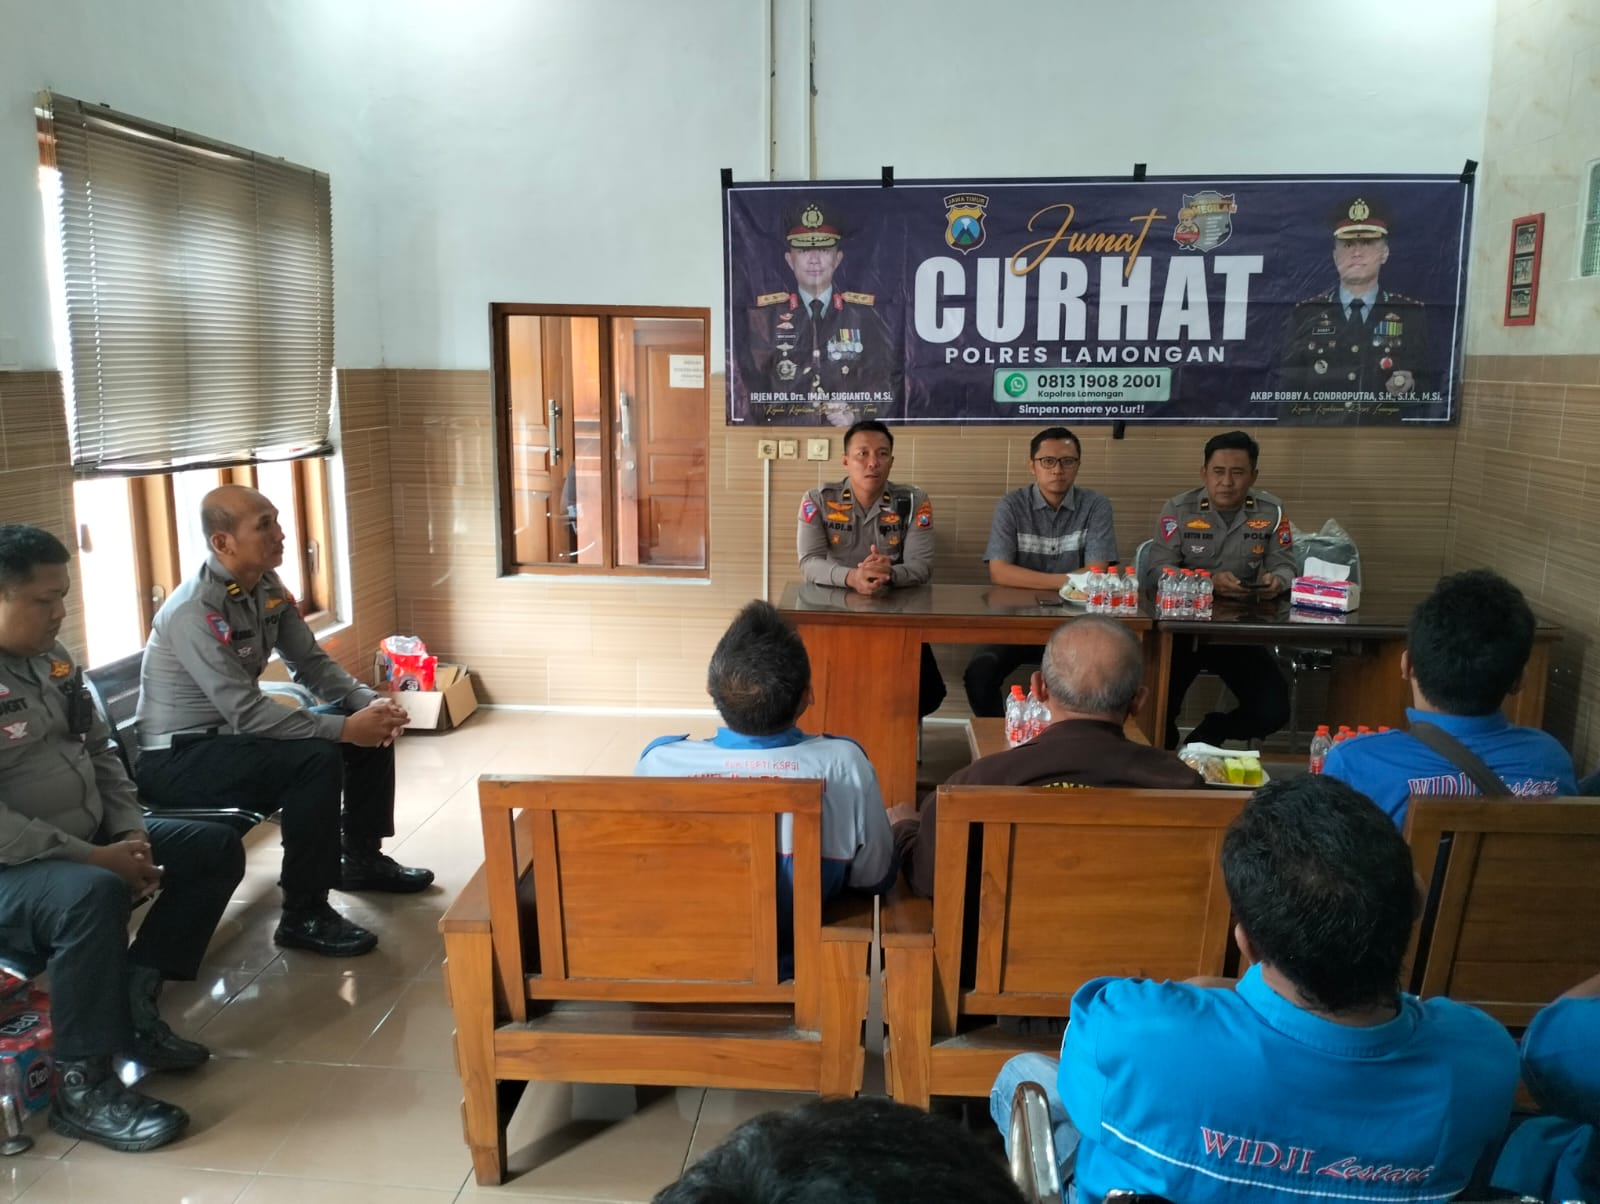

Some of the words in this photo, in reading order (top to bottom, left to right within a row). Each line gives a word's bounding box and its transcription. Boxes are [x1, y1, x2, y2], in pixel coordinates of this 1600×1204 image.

[1010, 203, 1168, 278] Jumat
[914, 255, 1265, 345] CURHAT
[945, 347, 1048, 365] POLRES
[1061, 345, 1225, 364] LAMONGAN
[1037, 374, 1076, 389] 0813
[1080, 374, 1119, 389] 1908
[1122, 374, 1162, 389] 2001
[750, 392, 772, 402] IRJEN
[774, 392, 788, 401] POL
[790, 392, 806, 401] Drs.
[808, 392, 830, 401] IMAM
[831, 392, 873, 402] SUGIANTO,
[874, 391, 893, 401] M.Si.
[1037, 390, 1076, 400] Kapolres
[1078, 390, 1124, 401] Lamongan
[1250, 391, 1273, 401] AKBP
[1275, 391, 1301, 401] BOBBY
[1303, 391, 1311, 401] A.
[1313, 391, 1377, 402] CONDROPUTRA,
[1421, 391, 1442, 401] M.Si.
[1019, 404, 1060, 416] Simpen
[1061, 406, 1104, 415] nomere
[1105, 406, 1119, 417] yo
[1120, 404, 1145, 415] Lur!!
[1200, 1125, 1316, 1175] WIDJI
[1315, 1156, 1436, 1182] Lestari
